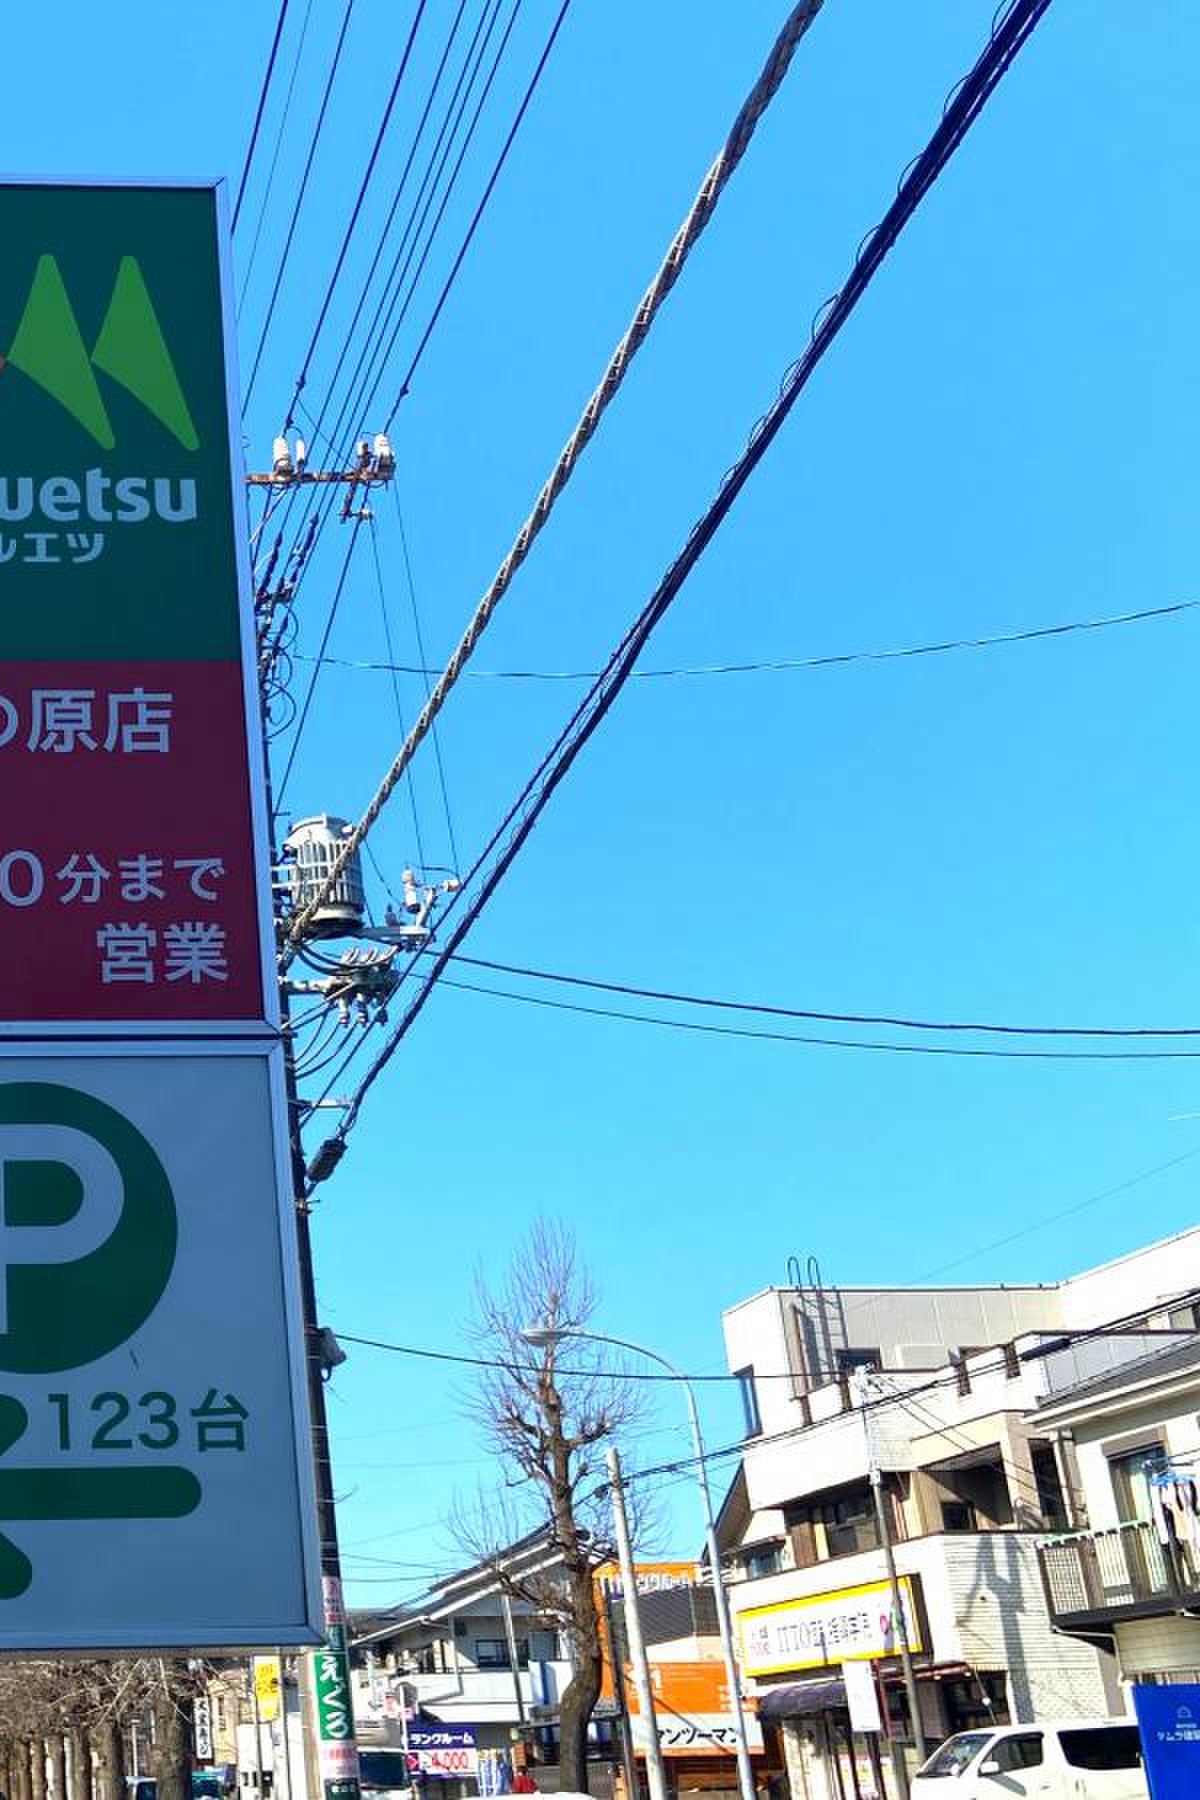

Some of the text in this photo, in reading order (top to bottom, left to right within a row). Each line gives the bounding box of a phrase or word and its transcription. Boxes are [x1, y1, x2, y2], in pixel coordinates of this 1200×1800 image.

[96, 922, 229, 984] 営業
[47, 1388, 250, 1452] 123台
[403, 1731, 475, 1745] ランクルーム
